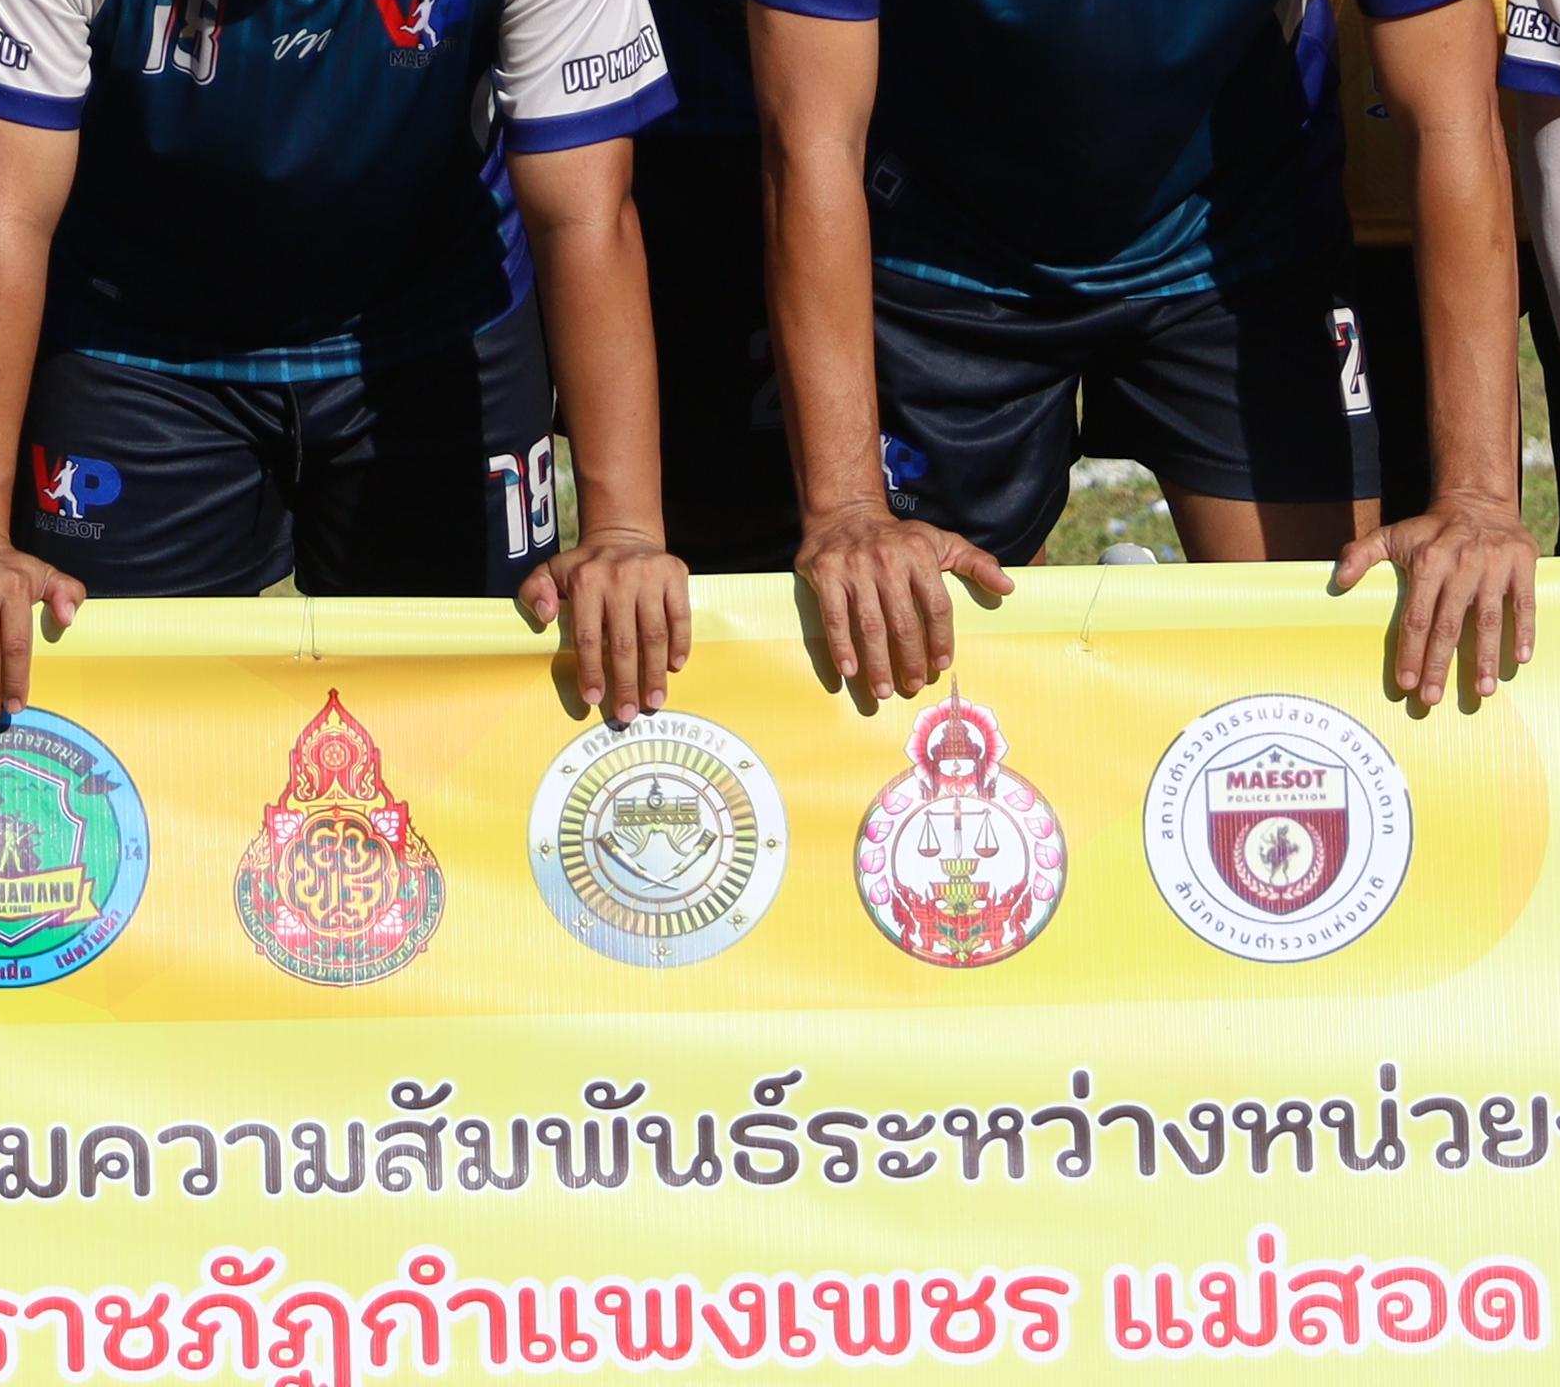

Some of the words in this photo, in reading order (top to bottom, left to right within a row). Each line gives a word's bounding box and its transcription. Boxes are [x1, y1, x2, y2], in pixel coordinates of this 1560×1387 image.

[562, 55, 606, 95] VIP
[1326, 307, 1371, 415] 2
[488, 434, 556, 559] 18
[35, 512, 104, 540] MAESOT
[1225, 769, 1327, 791] MAESOT
[1227, 793, 1271, 803] POLICE
[1275, 793, 1327, 802] STATION
[1114, 1231, 1541, 1349] แม่สอด
